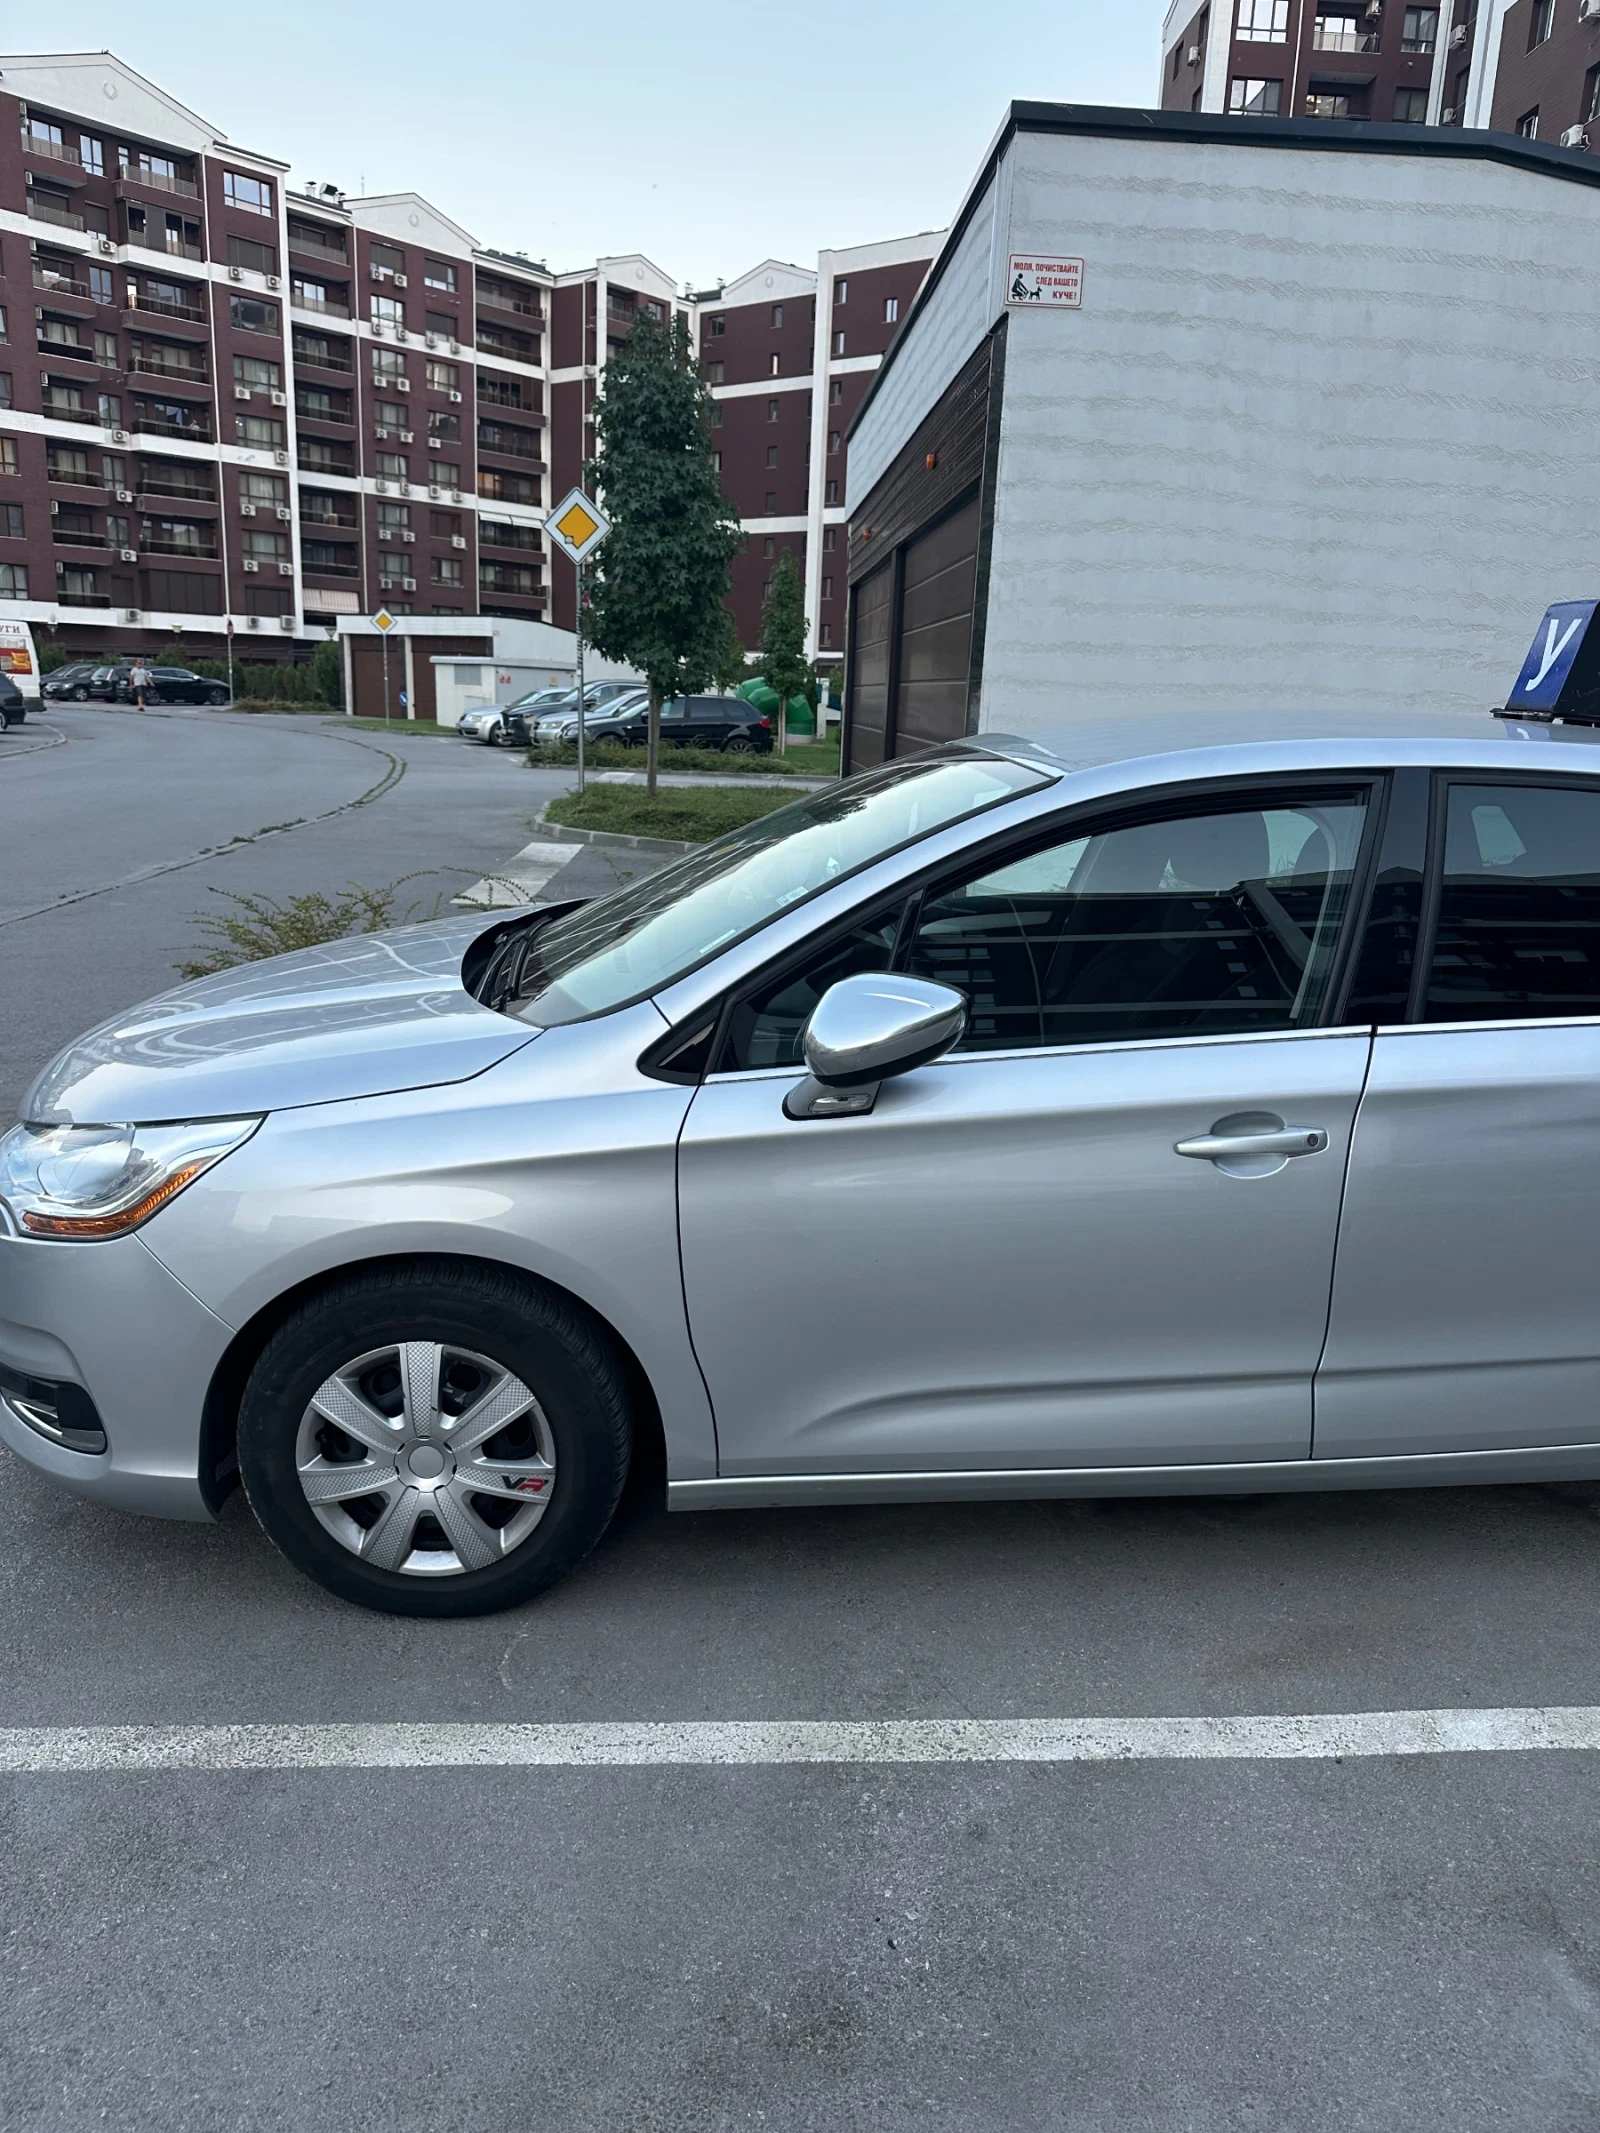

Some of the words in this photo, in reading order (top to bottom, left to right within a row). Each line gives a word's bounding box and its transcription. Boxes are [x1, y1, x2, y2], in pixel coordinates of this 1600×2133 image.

[1013, 261, 1034, 272] МОЛЯ,
[1035, 263, 1079, 274] ПОЧИСТВАЙТЕ
[1035, 276, 1052, 287] СЛЕД
[1053, 277, 1078, 287] ВАШЕТО
[1052, 290, 1077, 300] КУЧЕ!
[501, 1475, 549, 1492] VR
